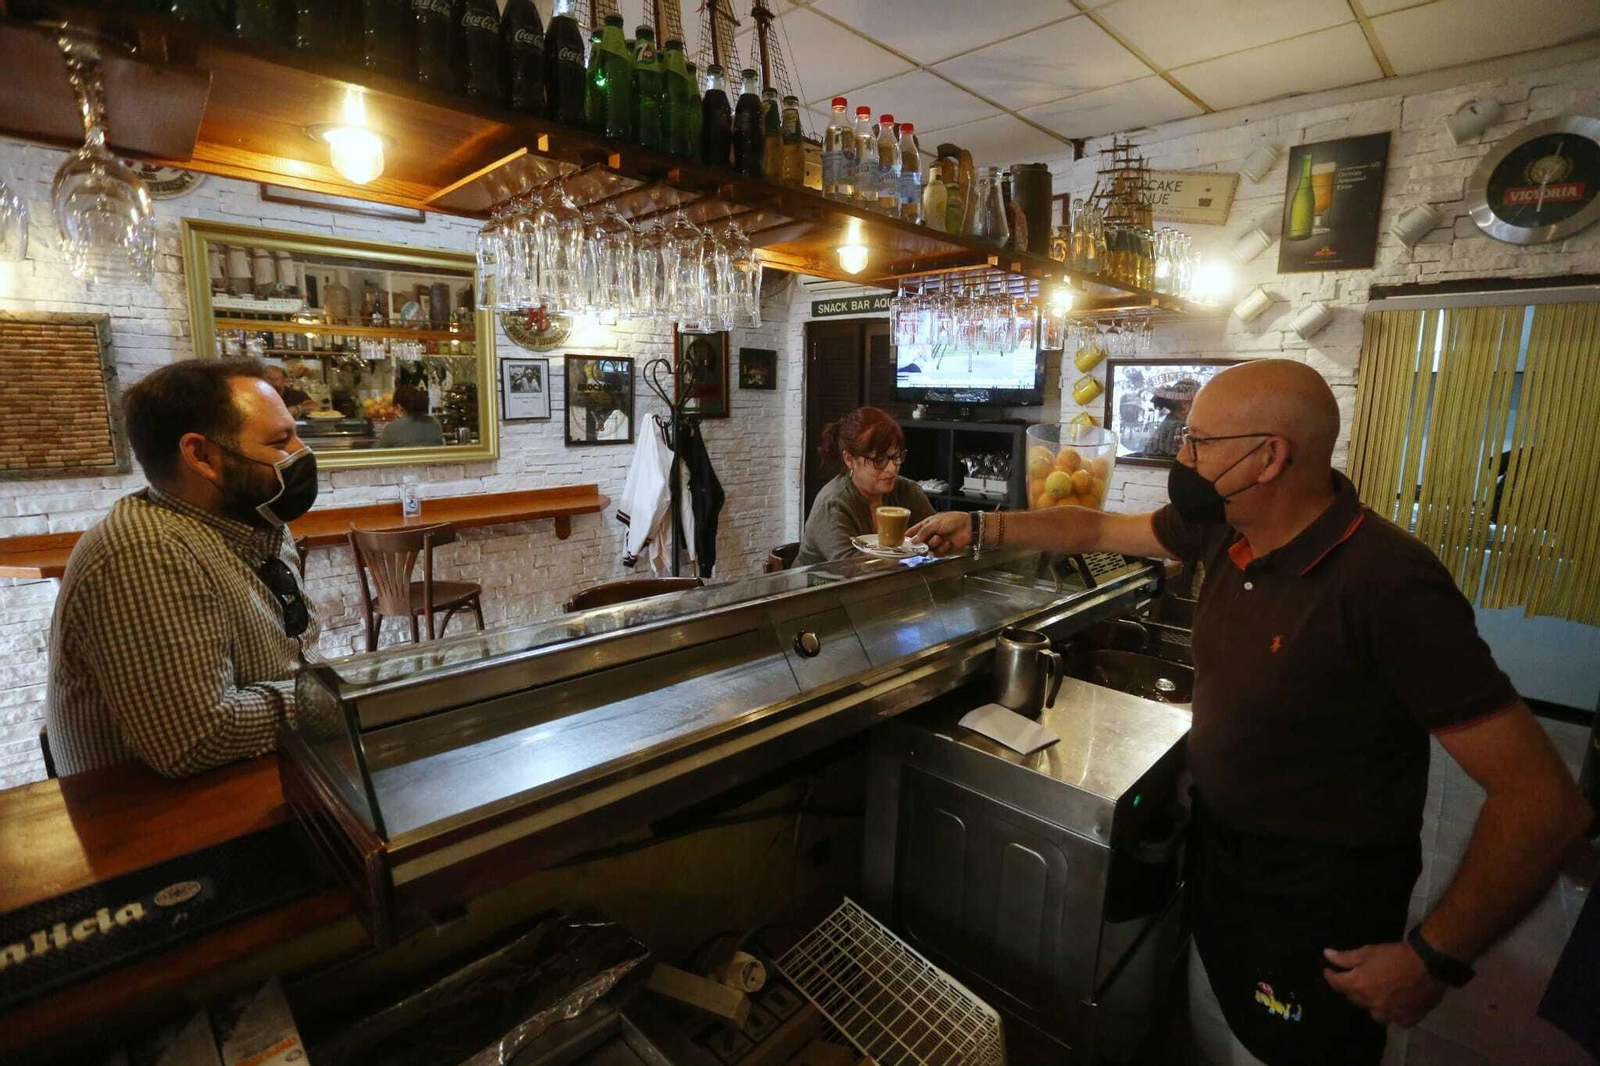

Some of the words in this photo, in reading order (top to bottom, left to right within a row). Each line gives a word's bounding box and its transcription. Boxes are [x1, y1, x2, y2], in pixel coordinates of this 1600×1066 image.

[1509, 185, 1578, 202] VICTORIA
[817, 301, 848, 314] SNACK
[851, 299, 870, 311] BAR
